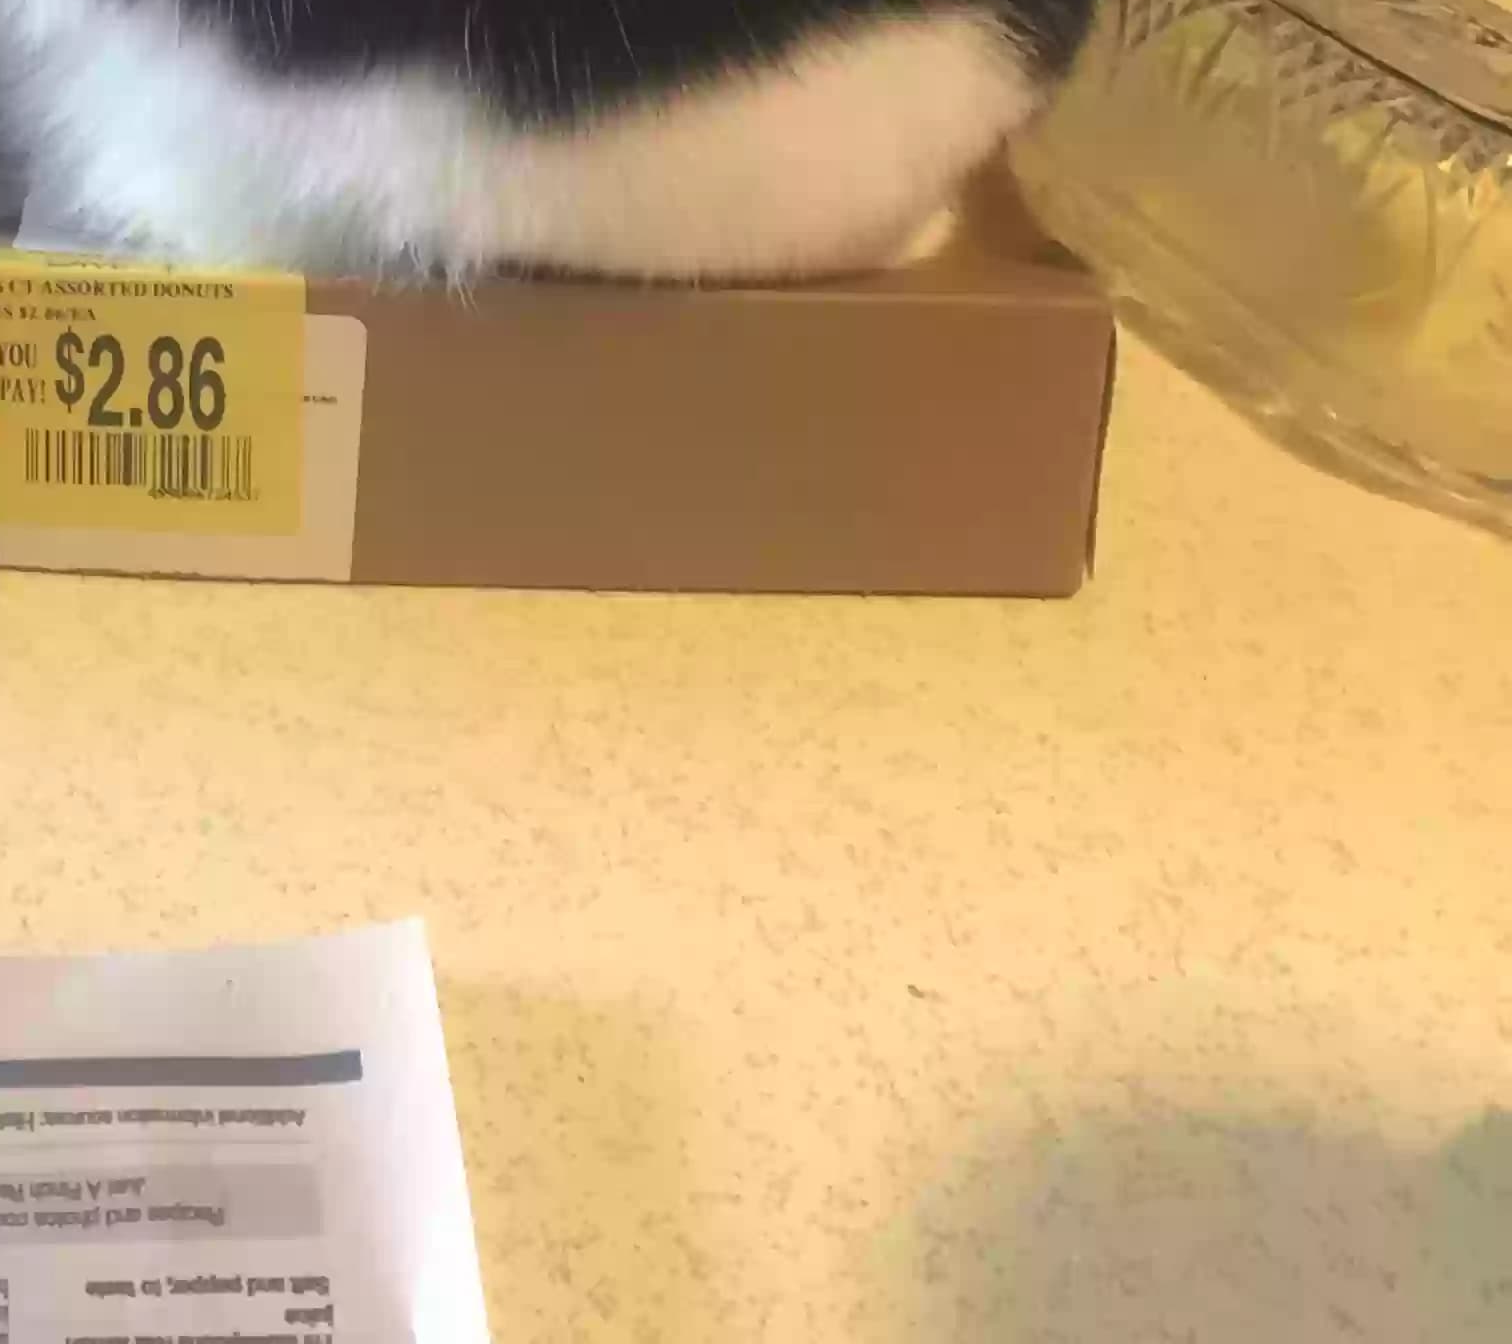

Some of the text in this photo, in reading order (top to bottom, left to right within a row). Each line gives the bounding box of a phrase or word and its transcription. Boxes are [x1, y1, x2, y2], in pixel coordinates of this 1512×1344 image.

[41, 279, 148, 298] ASSORTED
[153, 282, 234, 300] DONUTS
[0, 377, 47, 405] PAY!
[55, 325, 226, 431] $2.86
